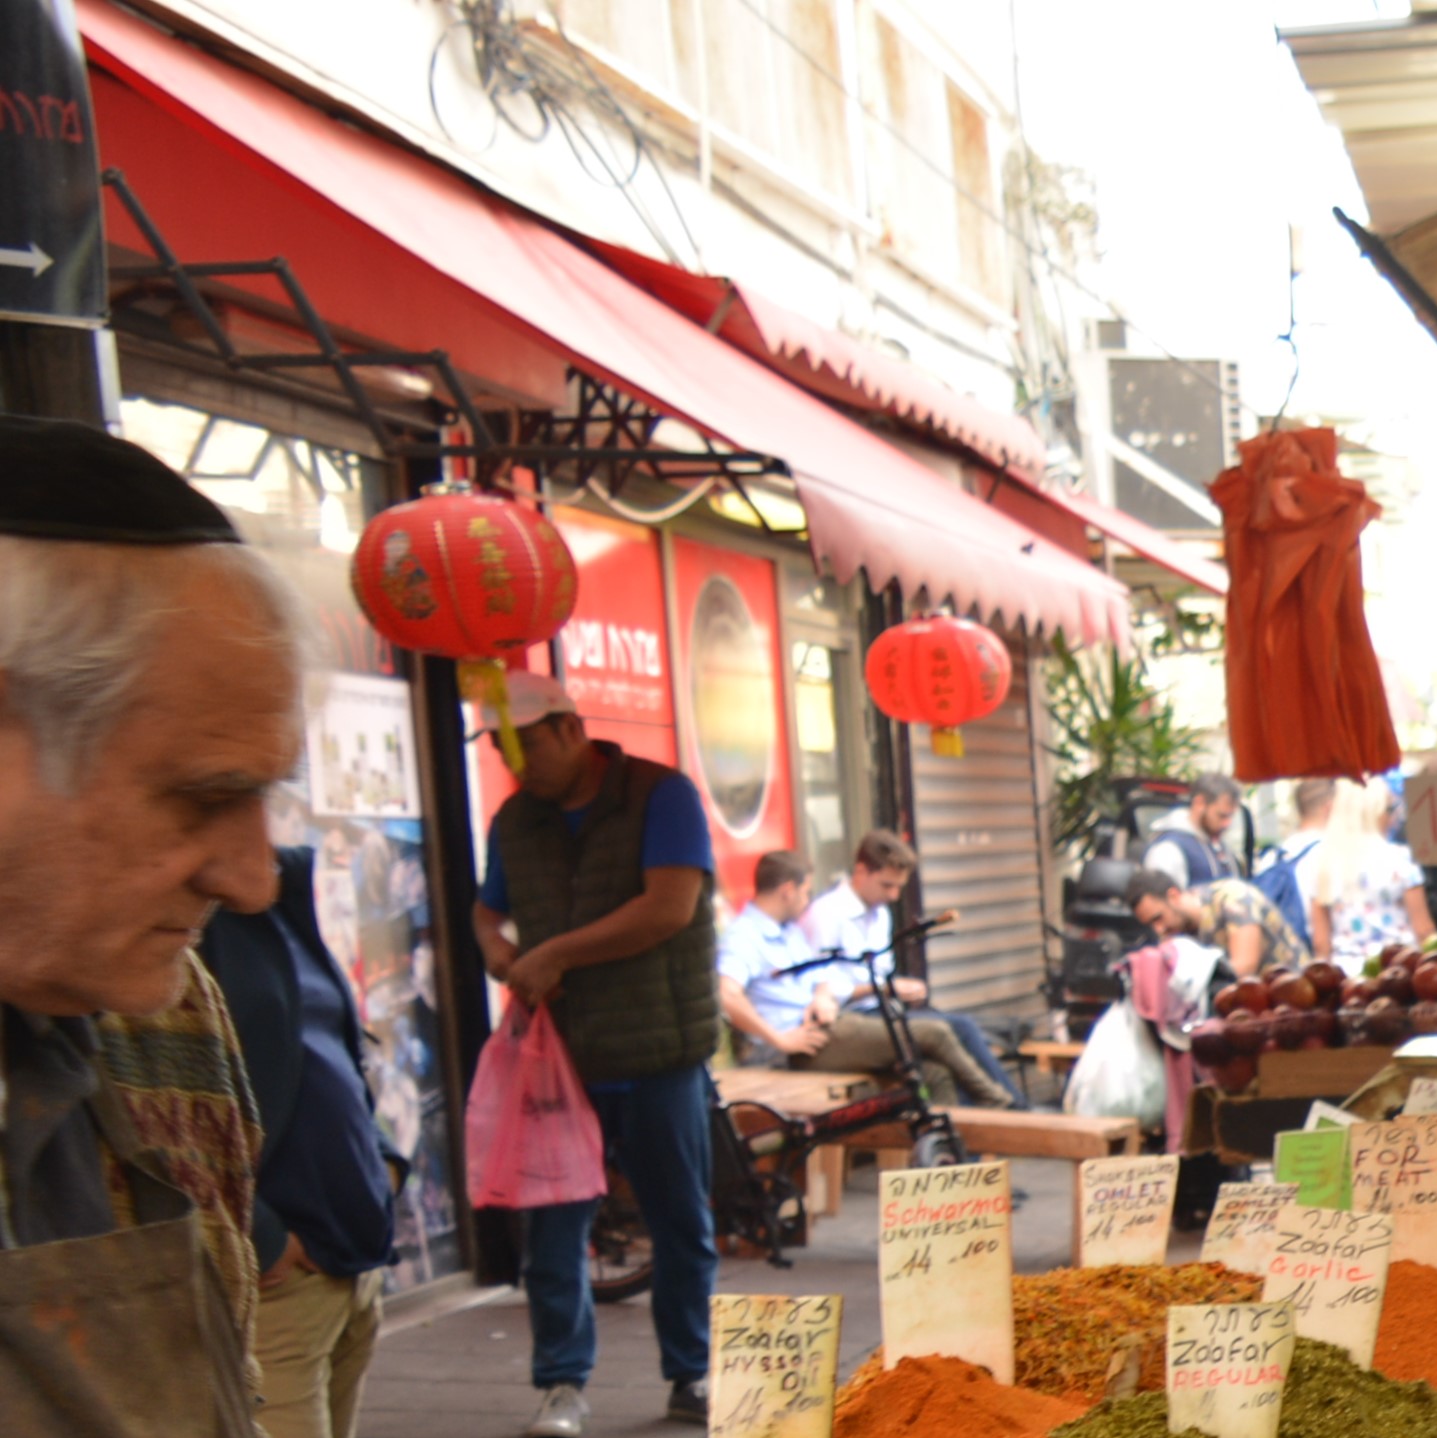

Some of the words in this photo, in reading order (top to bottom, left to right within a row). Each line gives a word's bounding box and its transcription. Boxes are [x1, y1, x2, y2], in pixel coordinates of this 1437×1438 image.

[1355, 1145, 1433, 1166] FOR
[1353, 1170, 1433, 1188] MEAT
[1094, 1181, 1166, 1202] OMLET
[1268, 1256, 1376, 1282] Garlic
[1172, 1364, 1286, 1392] REGULAR
